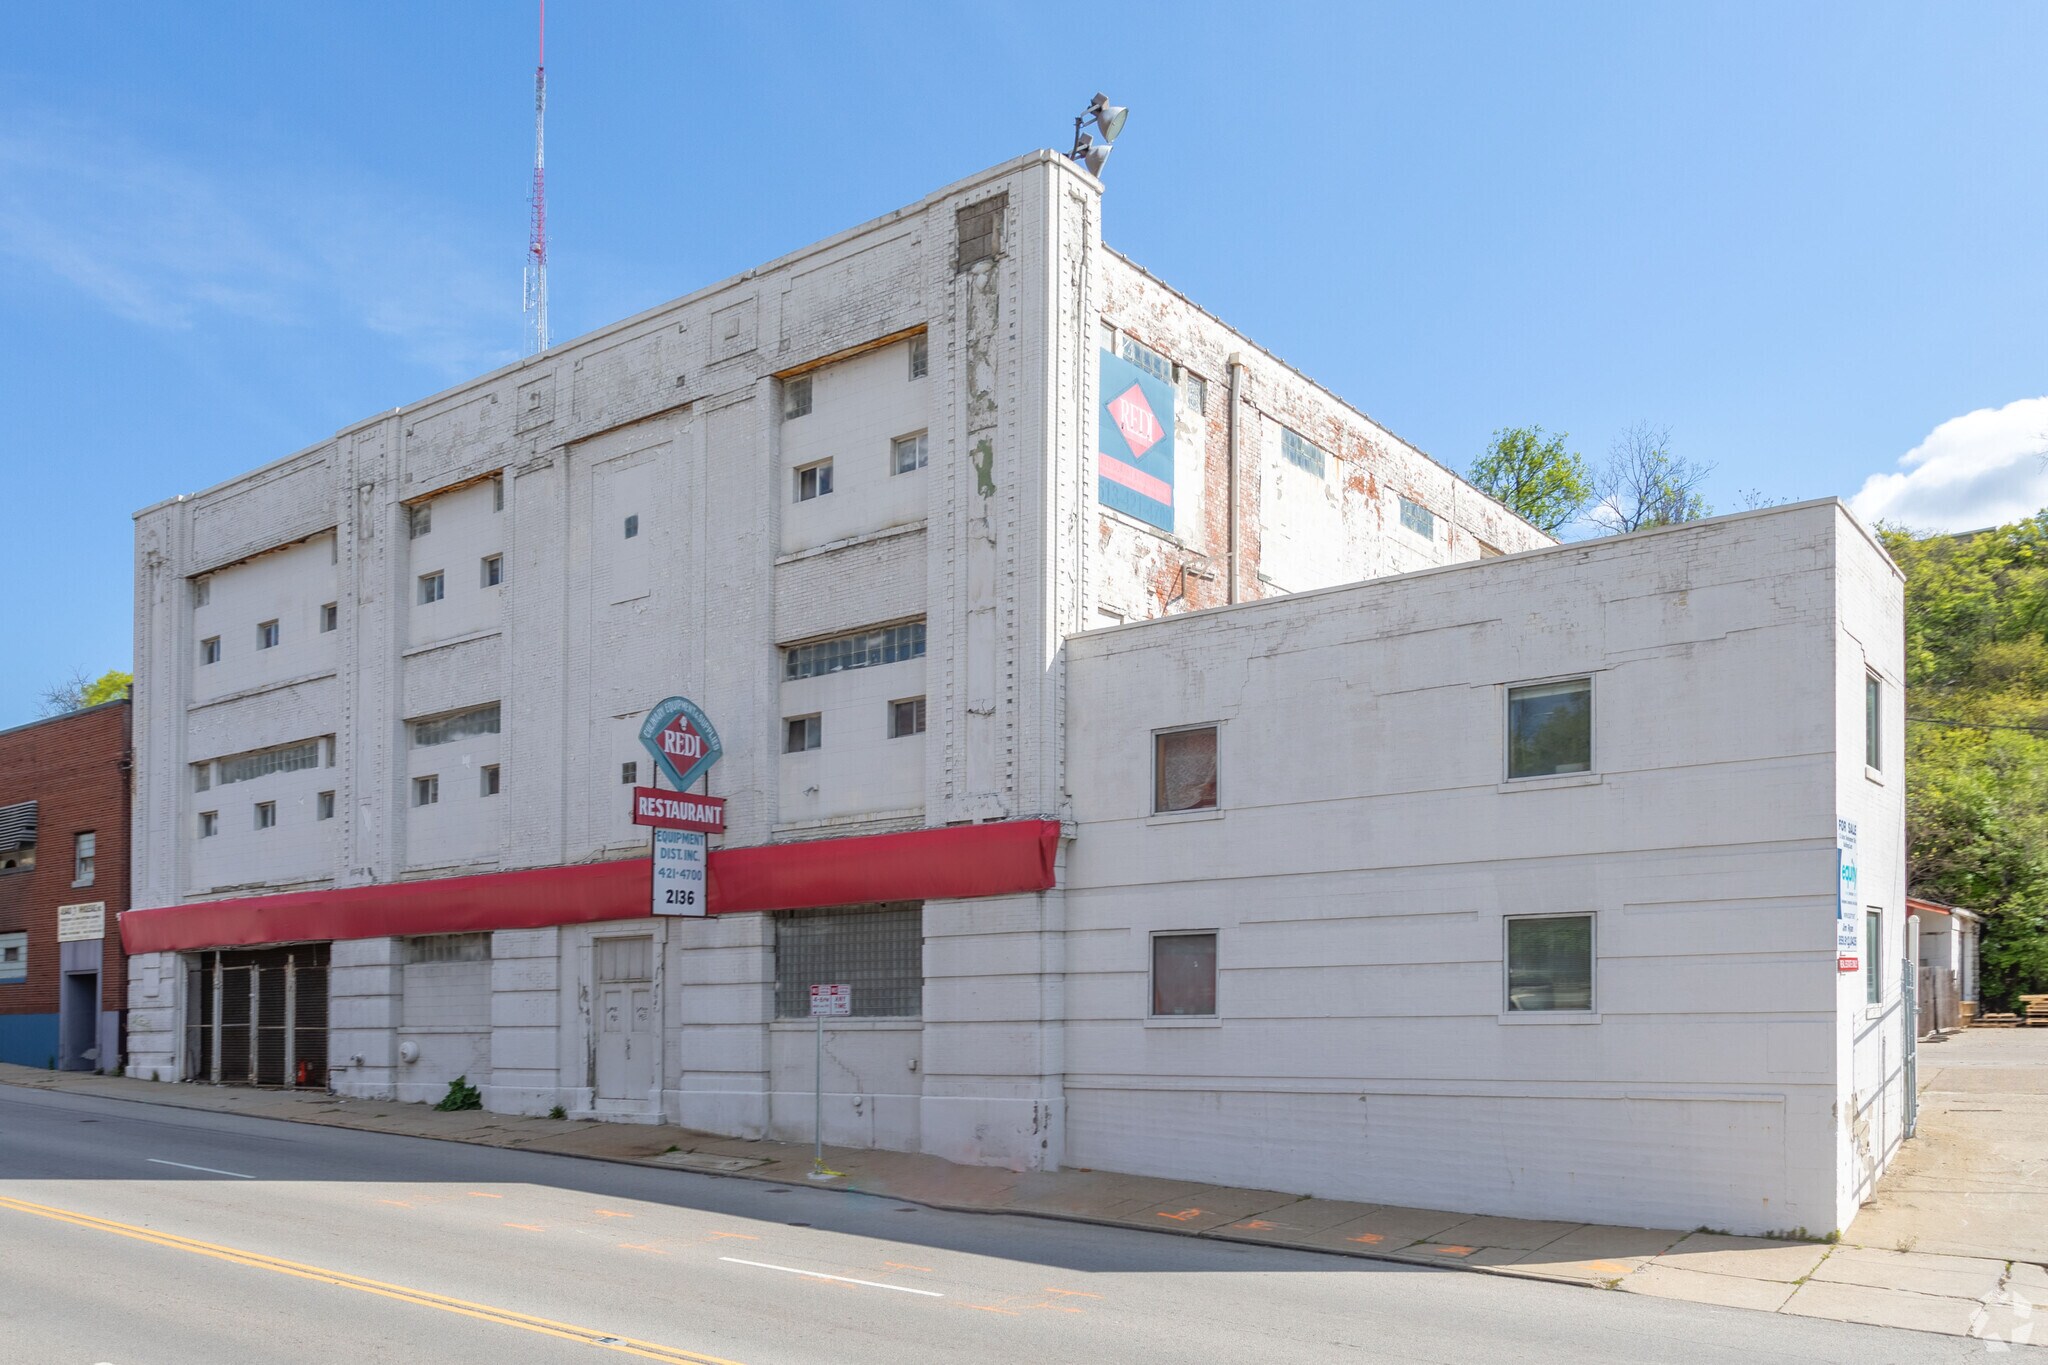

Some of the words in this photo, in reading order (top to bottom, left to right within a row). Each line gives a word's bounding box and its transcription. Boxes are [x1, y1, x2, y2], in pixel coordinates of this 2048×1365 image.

[1120, 398, 1154, 443] REDI
[643, 707, 666, 738] CULINARY
[664, 699, 697, 716] EQUIPMENT
[664, 729, 701, 759] REDI
[639, 796, 722, 825] RESTAURANT
[656, 830, 705, 846] EQUIPMENT
[1838, 819, 1847, 832] FOR
[1847, 822, 1857, 836] SALE
[658, 867, 703, 881] 421-4700
[665, 889, 695, 905] 2136
